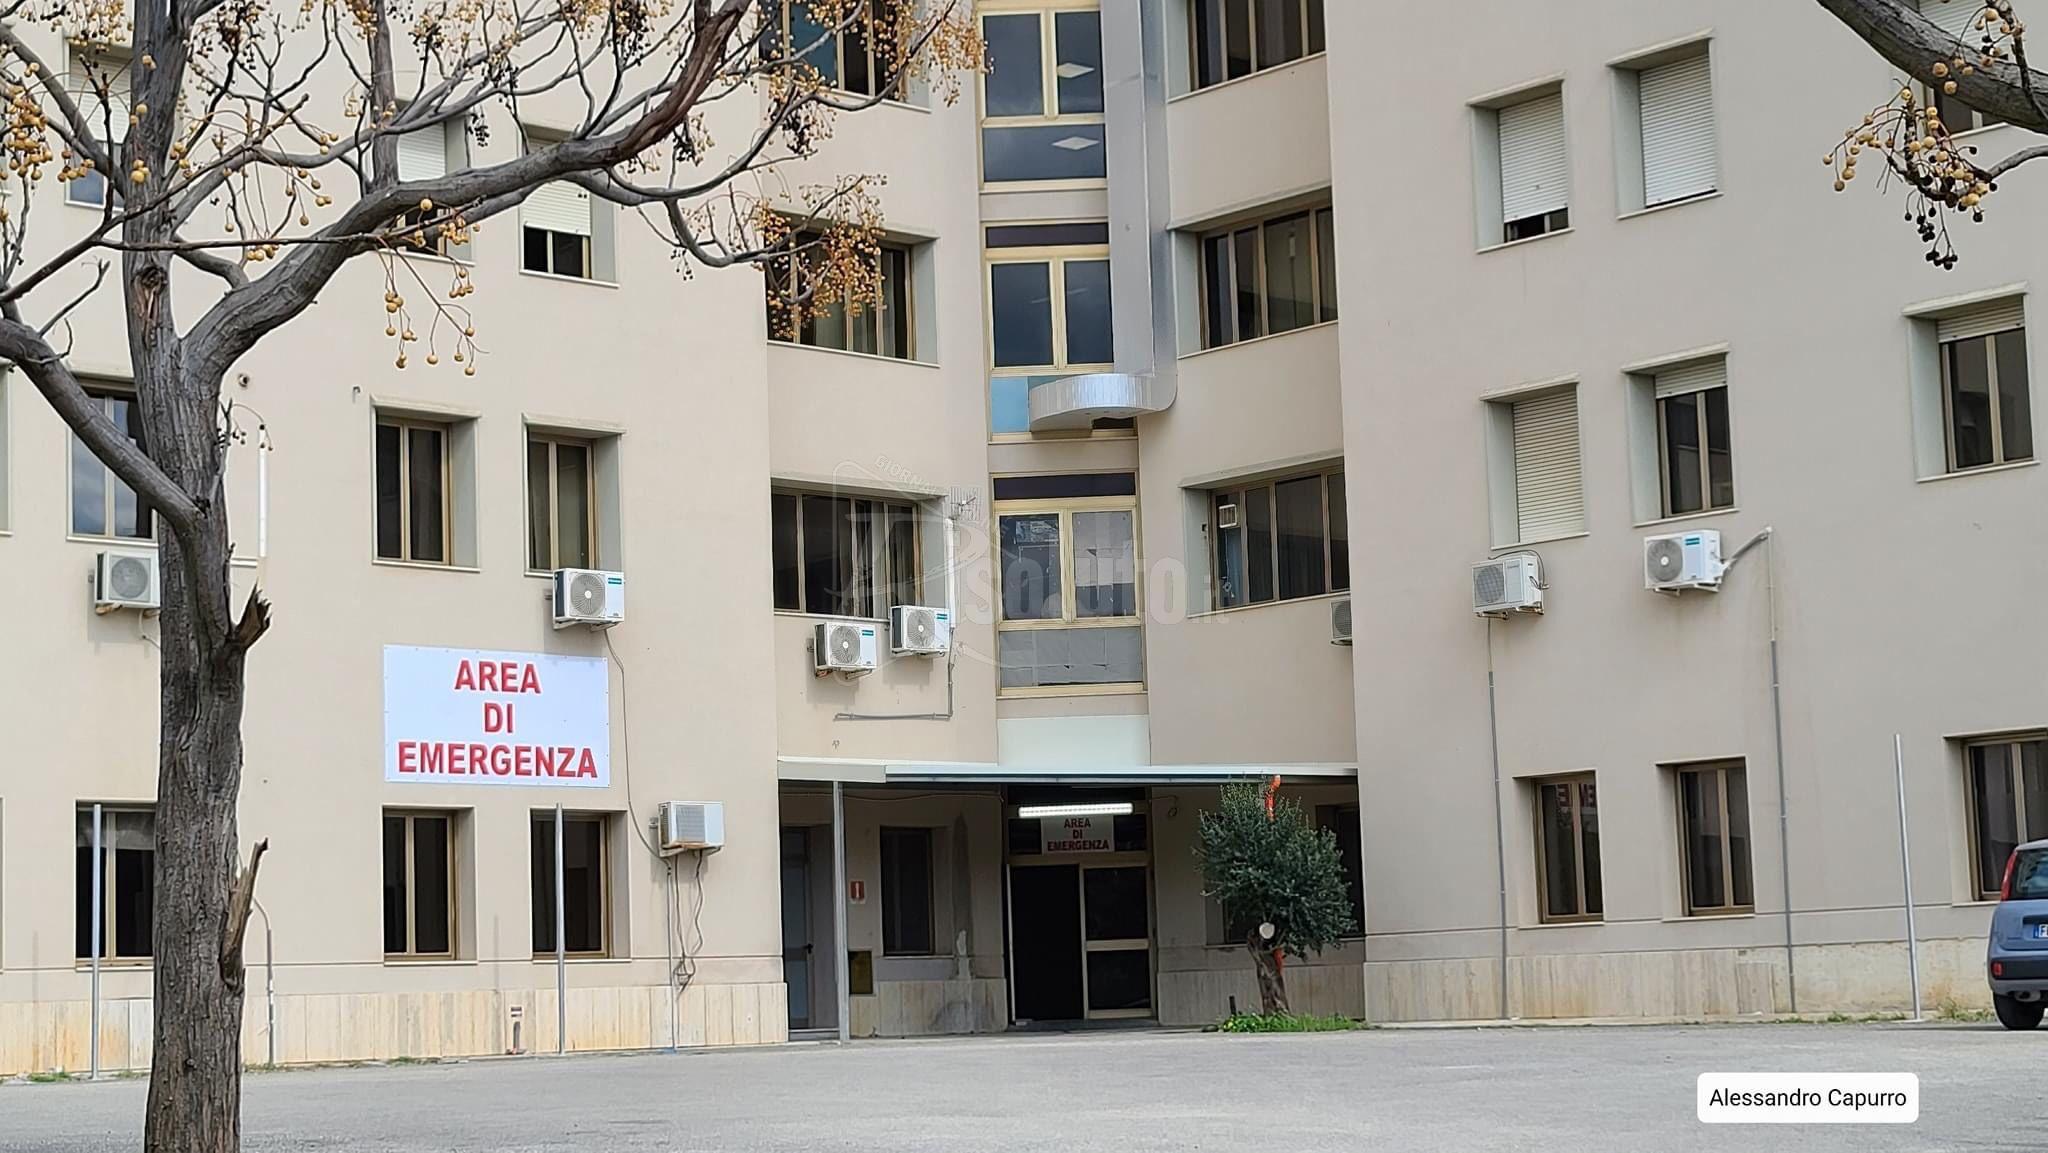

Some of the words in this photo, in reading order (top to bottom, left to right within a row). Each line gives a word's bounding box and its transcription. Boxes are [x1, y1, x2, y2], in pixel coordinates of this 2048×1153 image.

[454, 660, 542, 694] AREA
[484, 702, 514, 734] DI
[398, 741, 598, 778] EMERGENZA
[1064, 818, 1091, 829] AREA
[1072, 829, 1083, 839] DI
[1047, 840, 1110, 852] EMERGENZA
